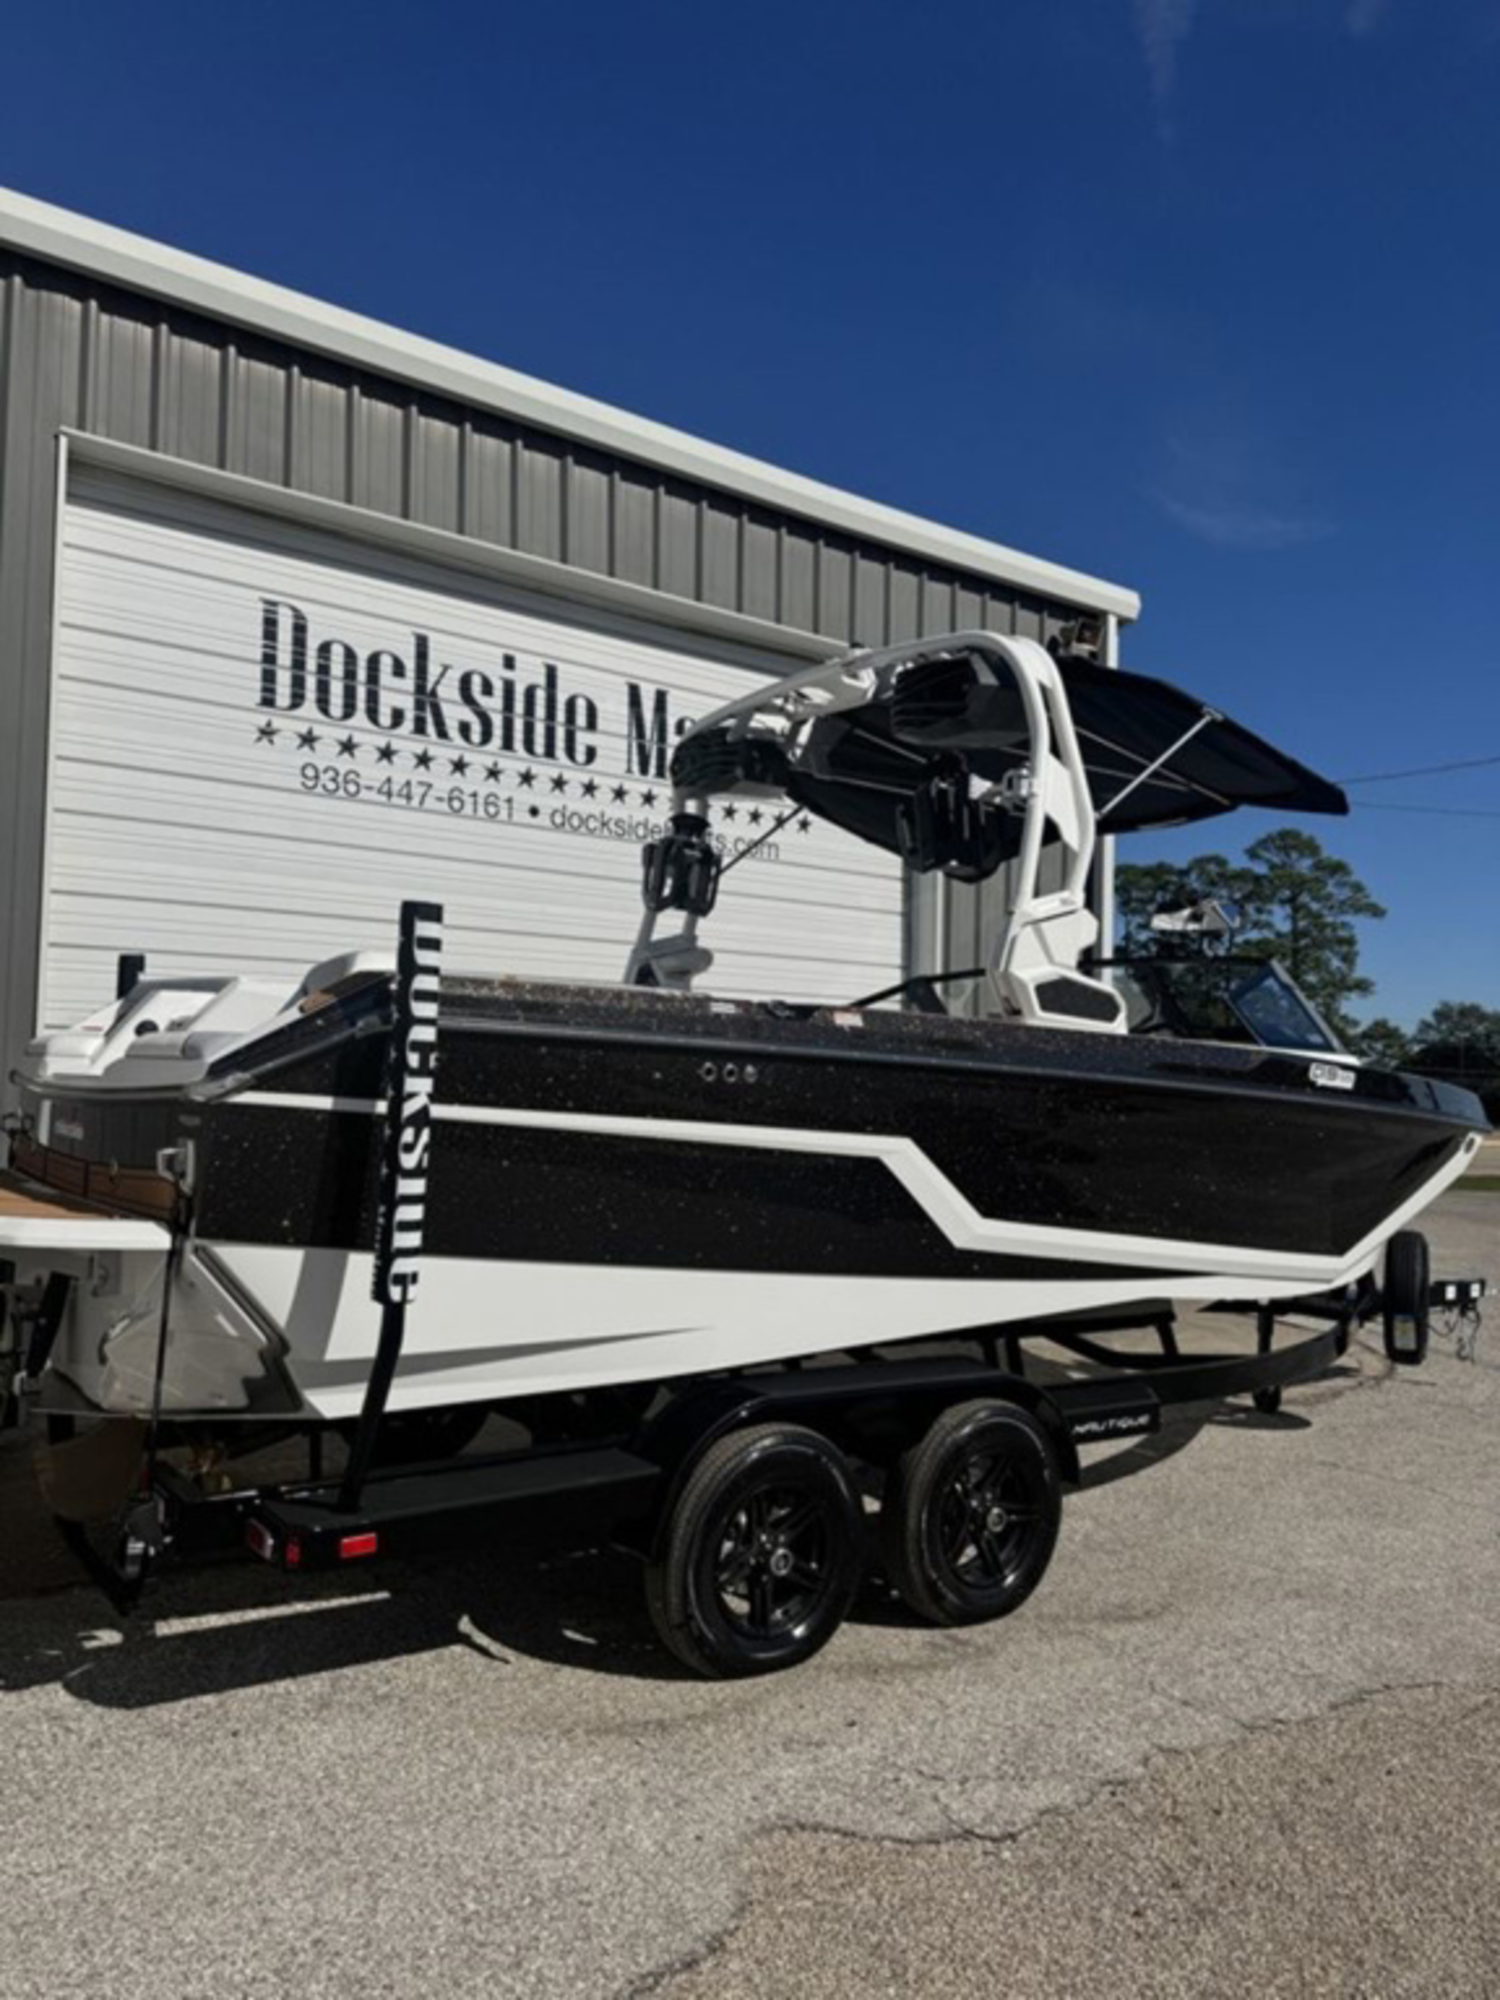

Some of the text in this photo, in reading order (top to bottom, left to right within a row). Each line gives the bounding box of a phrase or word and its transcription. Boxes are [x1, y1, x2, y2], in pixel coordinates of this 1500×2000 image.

[257, 597, 599, 767] Dockside
[301, 762, 780, 861] 936-447-6161 docksidets.com
